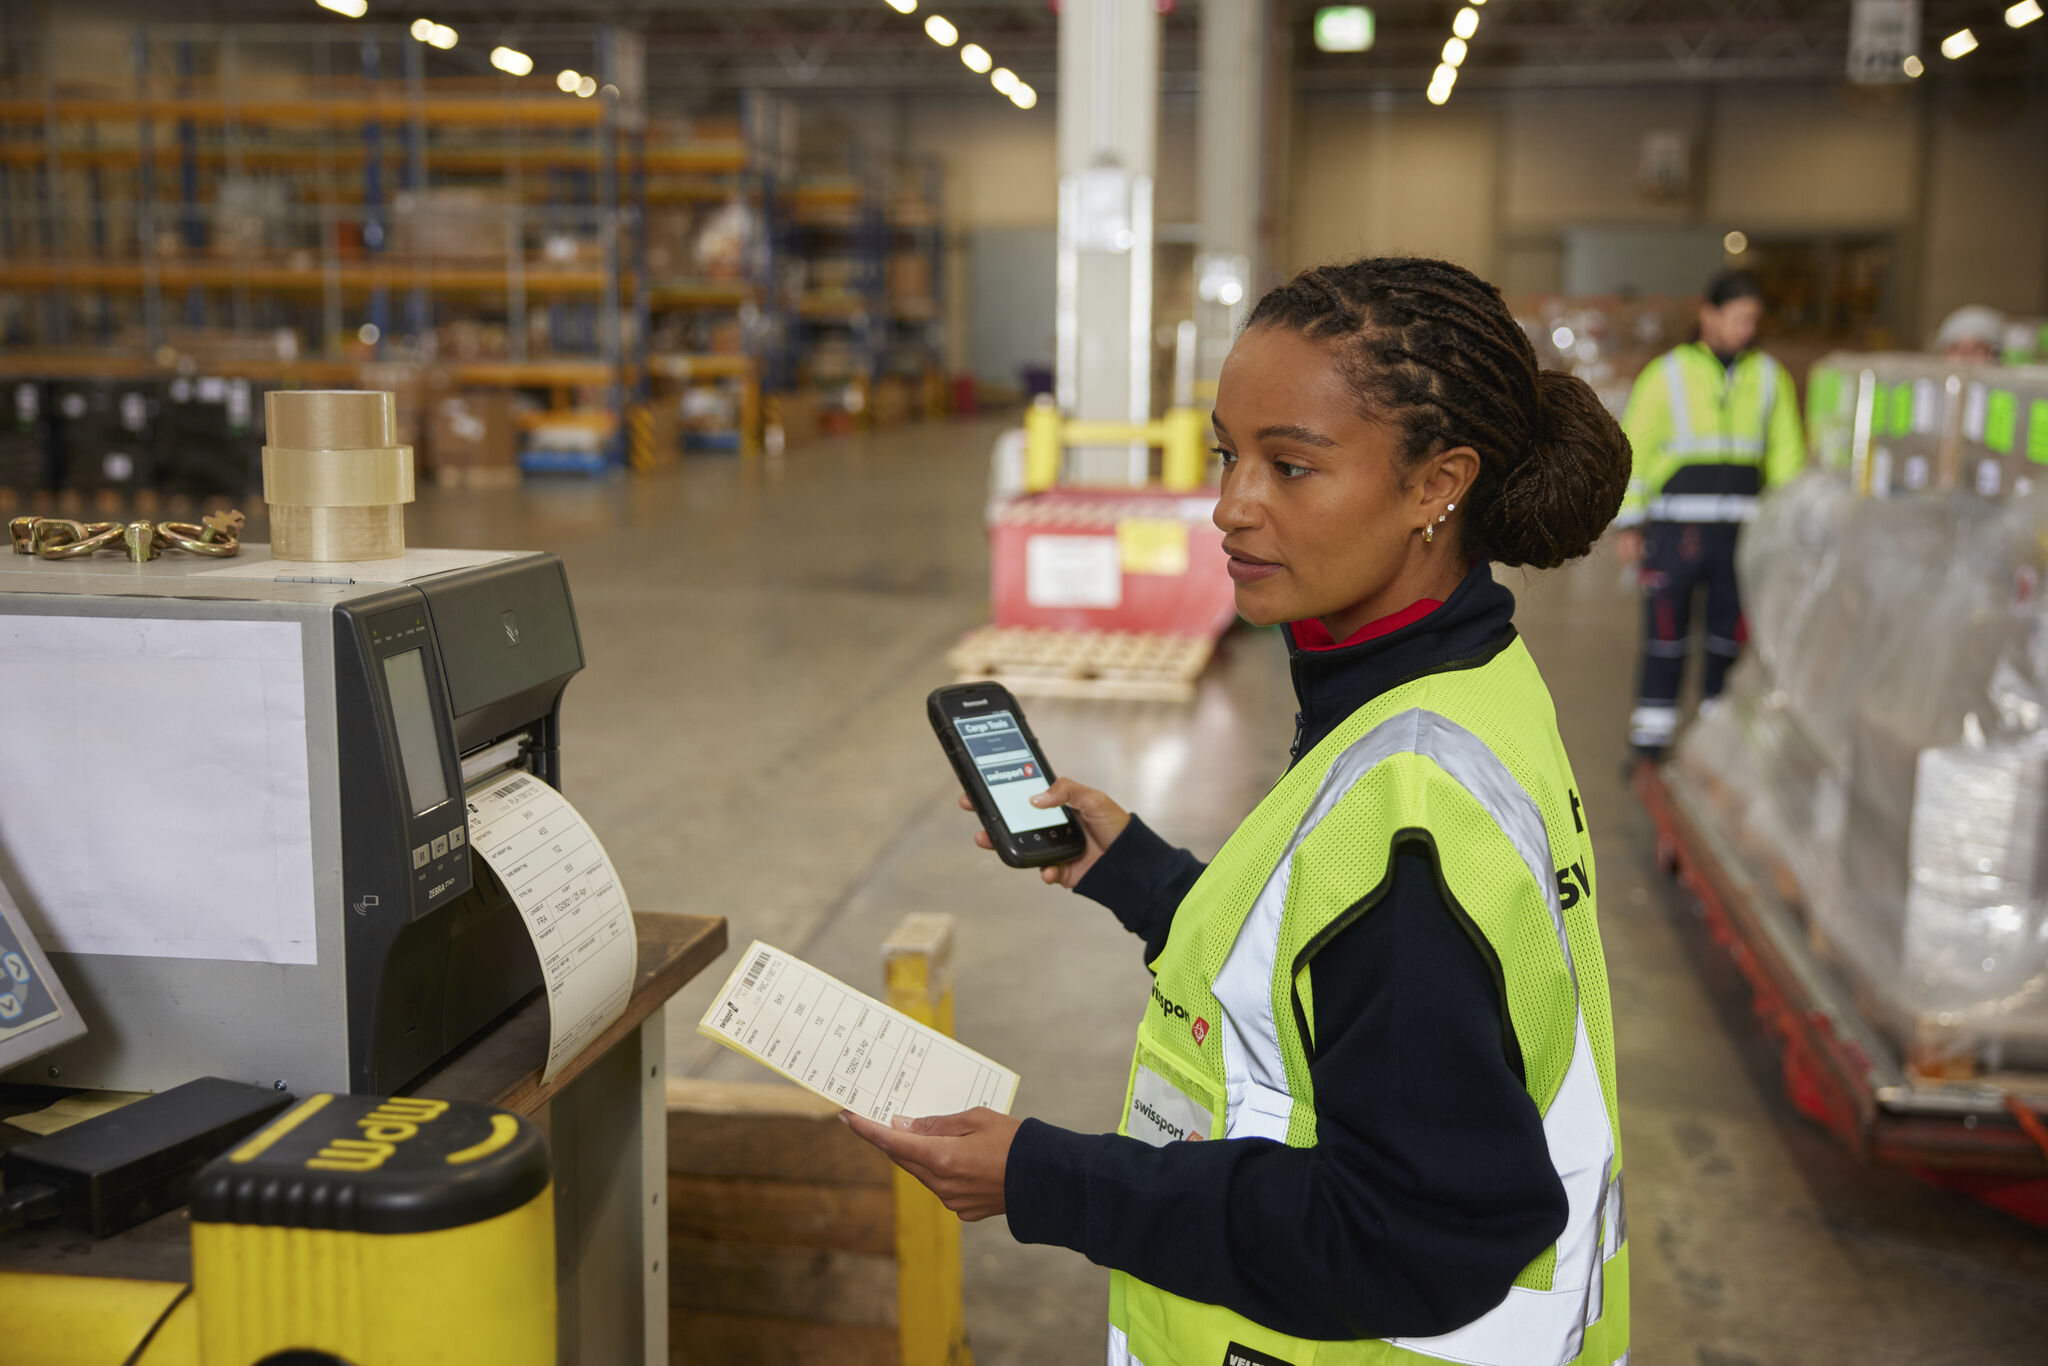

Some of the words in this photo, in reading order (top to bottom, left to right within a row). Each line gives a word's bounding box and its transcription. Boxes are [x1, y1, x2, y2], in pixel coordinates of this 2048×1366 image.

[964, 723, 989, 733] Cargo
[986, 719, 1009, 730] Tools
[986, 767, 1024, 781] swissport
[428, 884, 445, 899] ZEBRA
[536, 915, 548, 926] FRA
[836, 1085, 847, 1096] FRA
[1134, 1099, 1185, 1142] swissport
